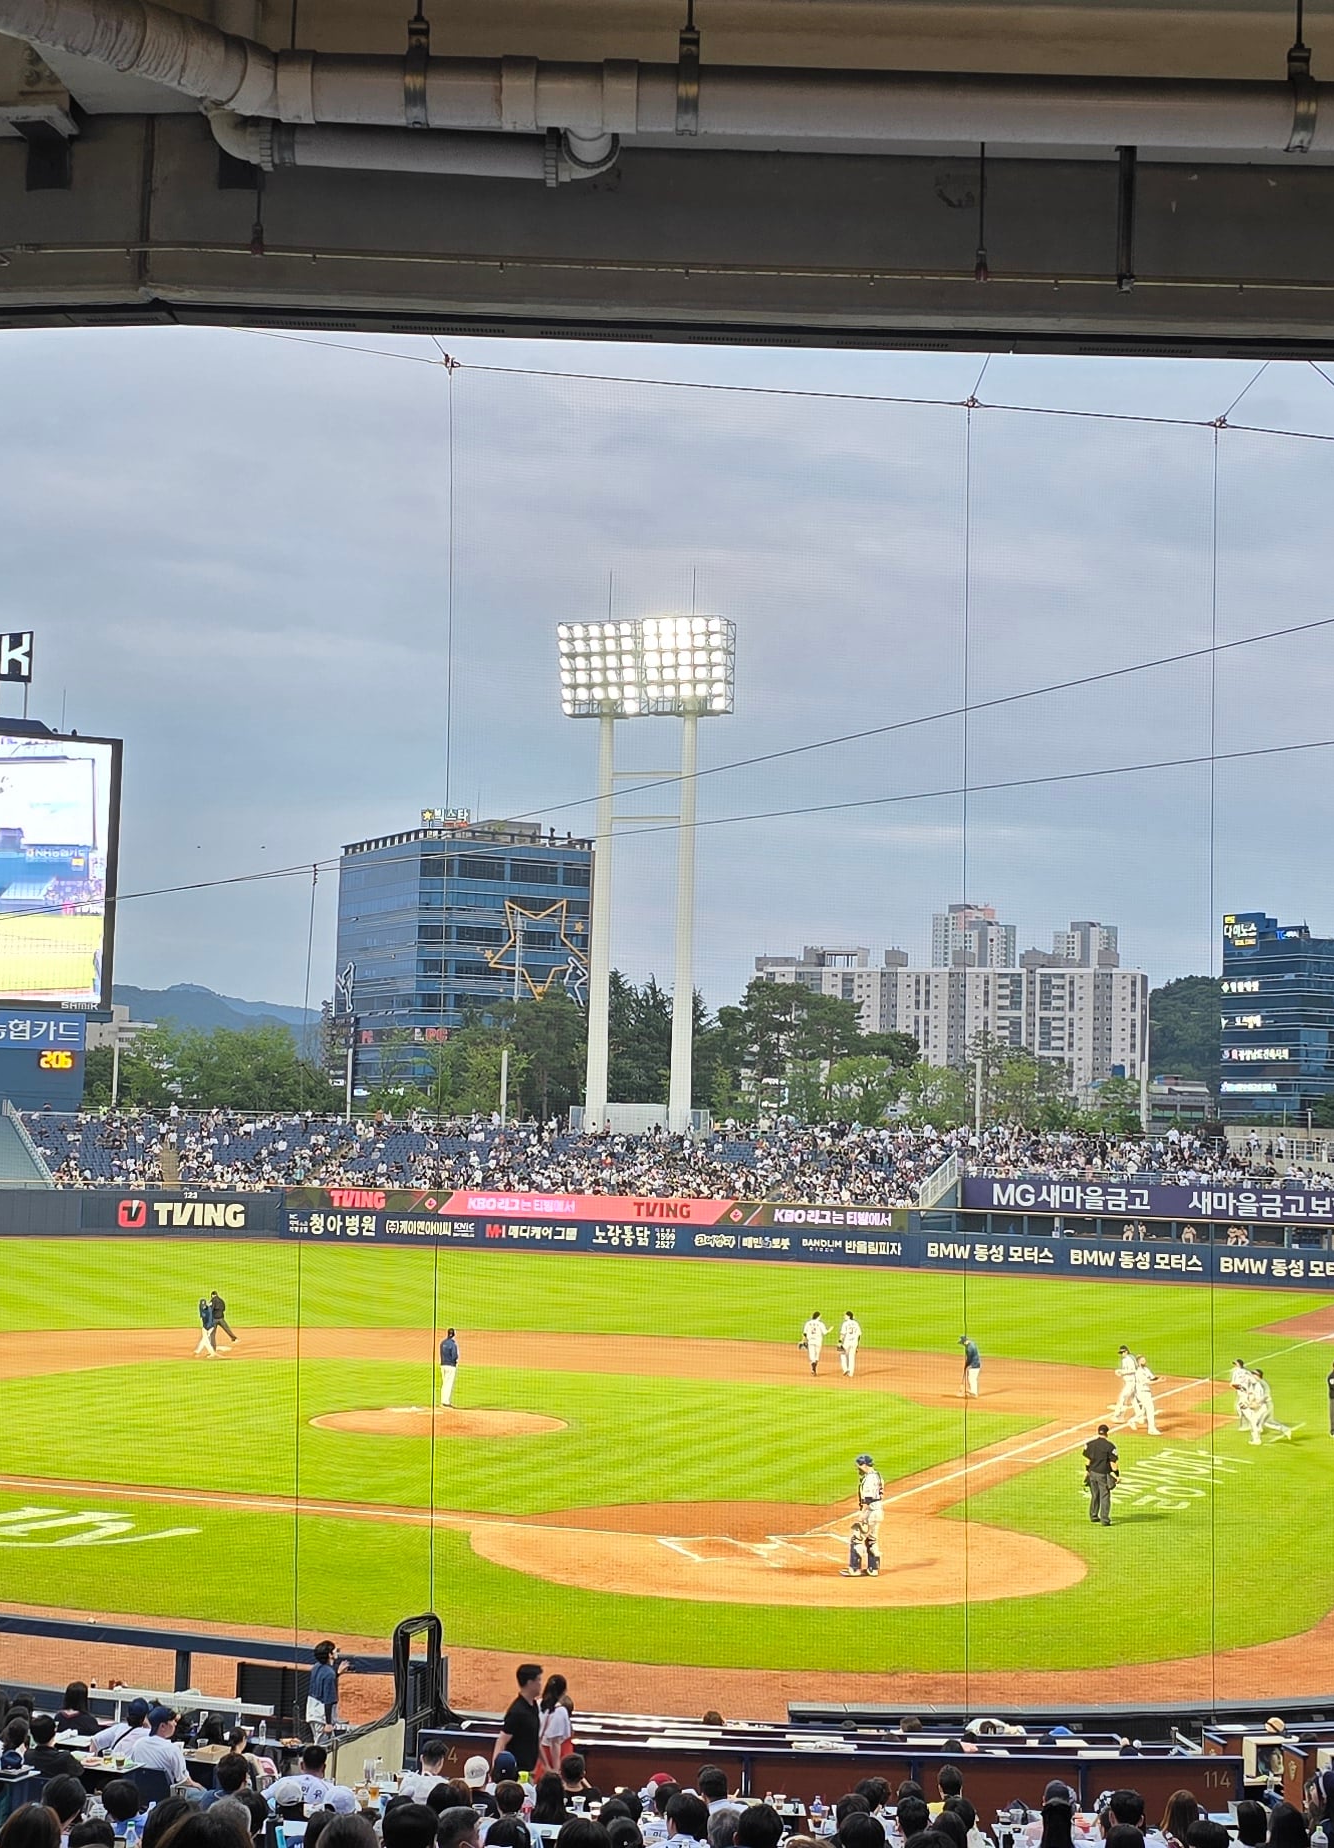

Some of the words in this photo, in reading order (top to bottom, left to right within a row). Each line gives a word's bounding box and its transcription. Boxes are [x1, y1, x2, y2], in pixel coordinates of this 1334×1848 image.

[435, 808, 468, 822] 빅스타
[183, 1191, 198, 1199] 123
[330, 1189, 386, 1210] TVING
[153, 1202, 246, 1228] TVING
[633, 1201, 691, 1219] TVING
[592, 1224, 651, 1247] 노랑통닭
[655, 1232, 676, 1241] 1599
[844, 1240, 902, 1256] 반올림피자
[927, 1242, 971, 1259] BMW
[973, 1243, 1004, 1263] 동성
[1008, 1245, 1054, 1264] 모터스
[1070, 1249, 1115, 1267] BMW
[1119, 1250, 1151, 1270] 동성
[1154, 1251, 1203, 1273] 모터스
[1220, 1256, 1267, 1275] BMW
[1271, 1258, 1304, 1278] 동성
[1203, 1770, 1231, 1788] 114
